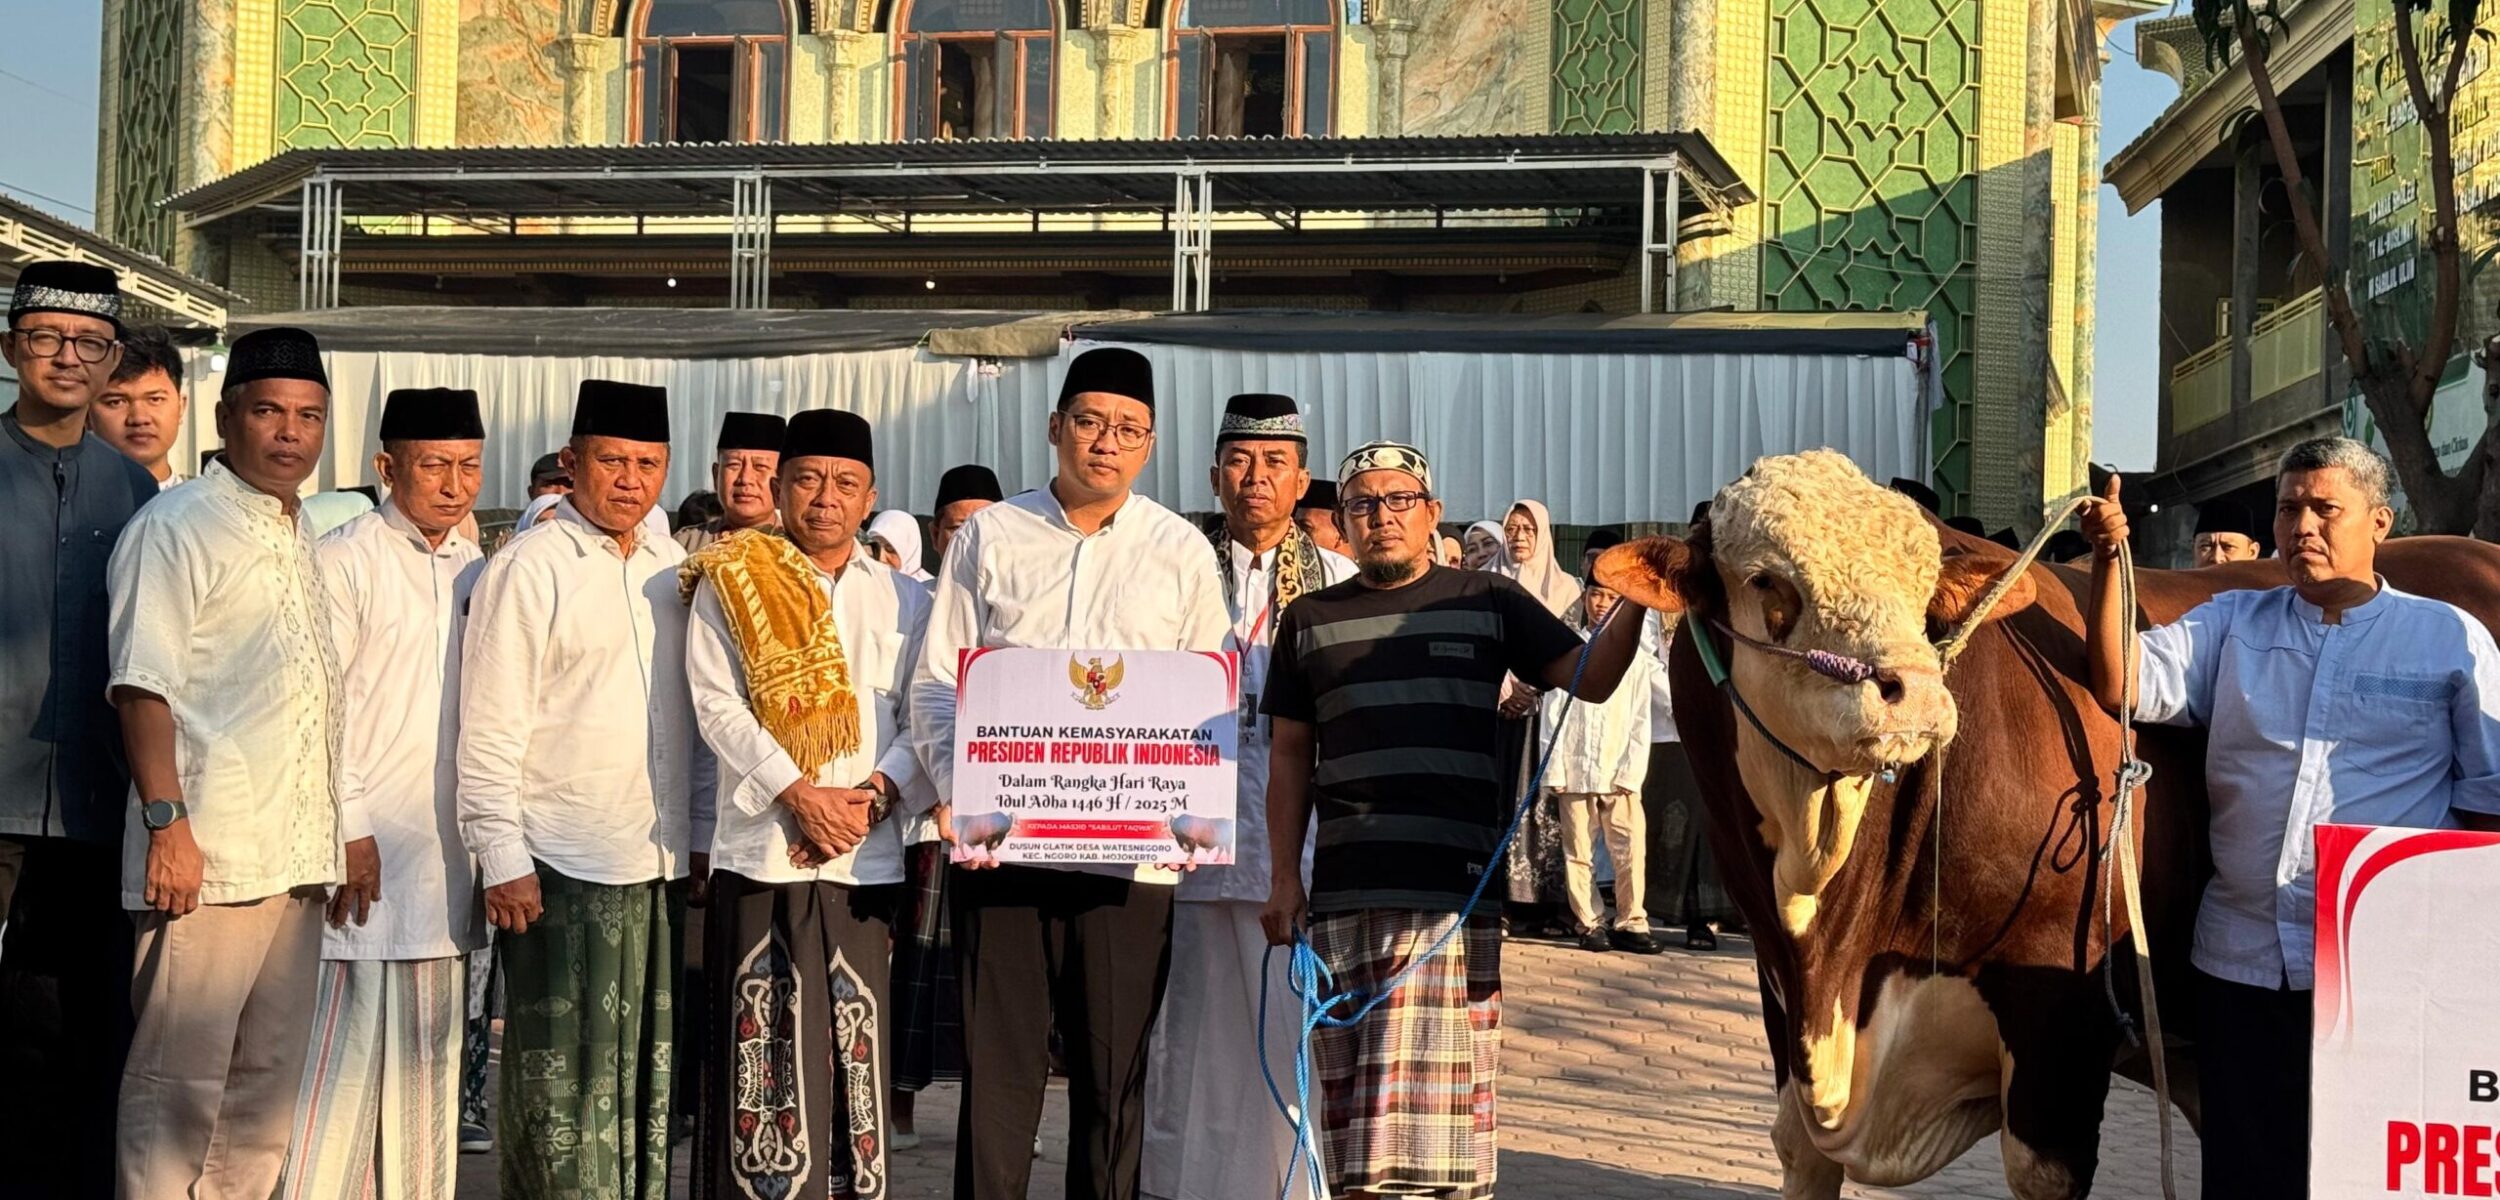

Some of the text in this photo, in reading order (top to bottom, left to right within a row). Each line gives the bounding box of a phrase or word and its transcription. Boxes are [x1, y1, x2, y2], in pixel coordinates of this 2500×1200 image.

[976, 725, 1213, 741] BANTUAN KEMASYARAKATAN
[967, 741, 1221, 766] PRESIDEN REPUBLIK INDONESIA
[998, 774, 1186, 793] Dalam Rangka Hari Raya
[995, 794, 1188, 813] Idul Adha 1446 H / 2025 M
[1027, 823, 1057, 831] KEPADA
[1059, 823, 1087, 831] MASJID
[1009, 842, 1041, 851] DUSUN
[1076, 843, 1100, 851] DESA
[1102, 843, 1172, 853] WATESNEGORO
[1022, 852, 1158, 862] KEC. NGORO KAB. MOJOKERTO
[2387, 1120, 2500, 1197] PRE
